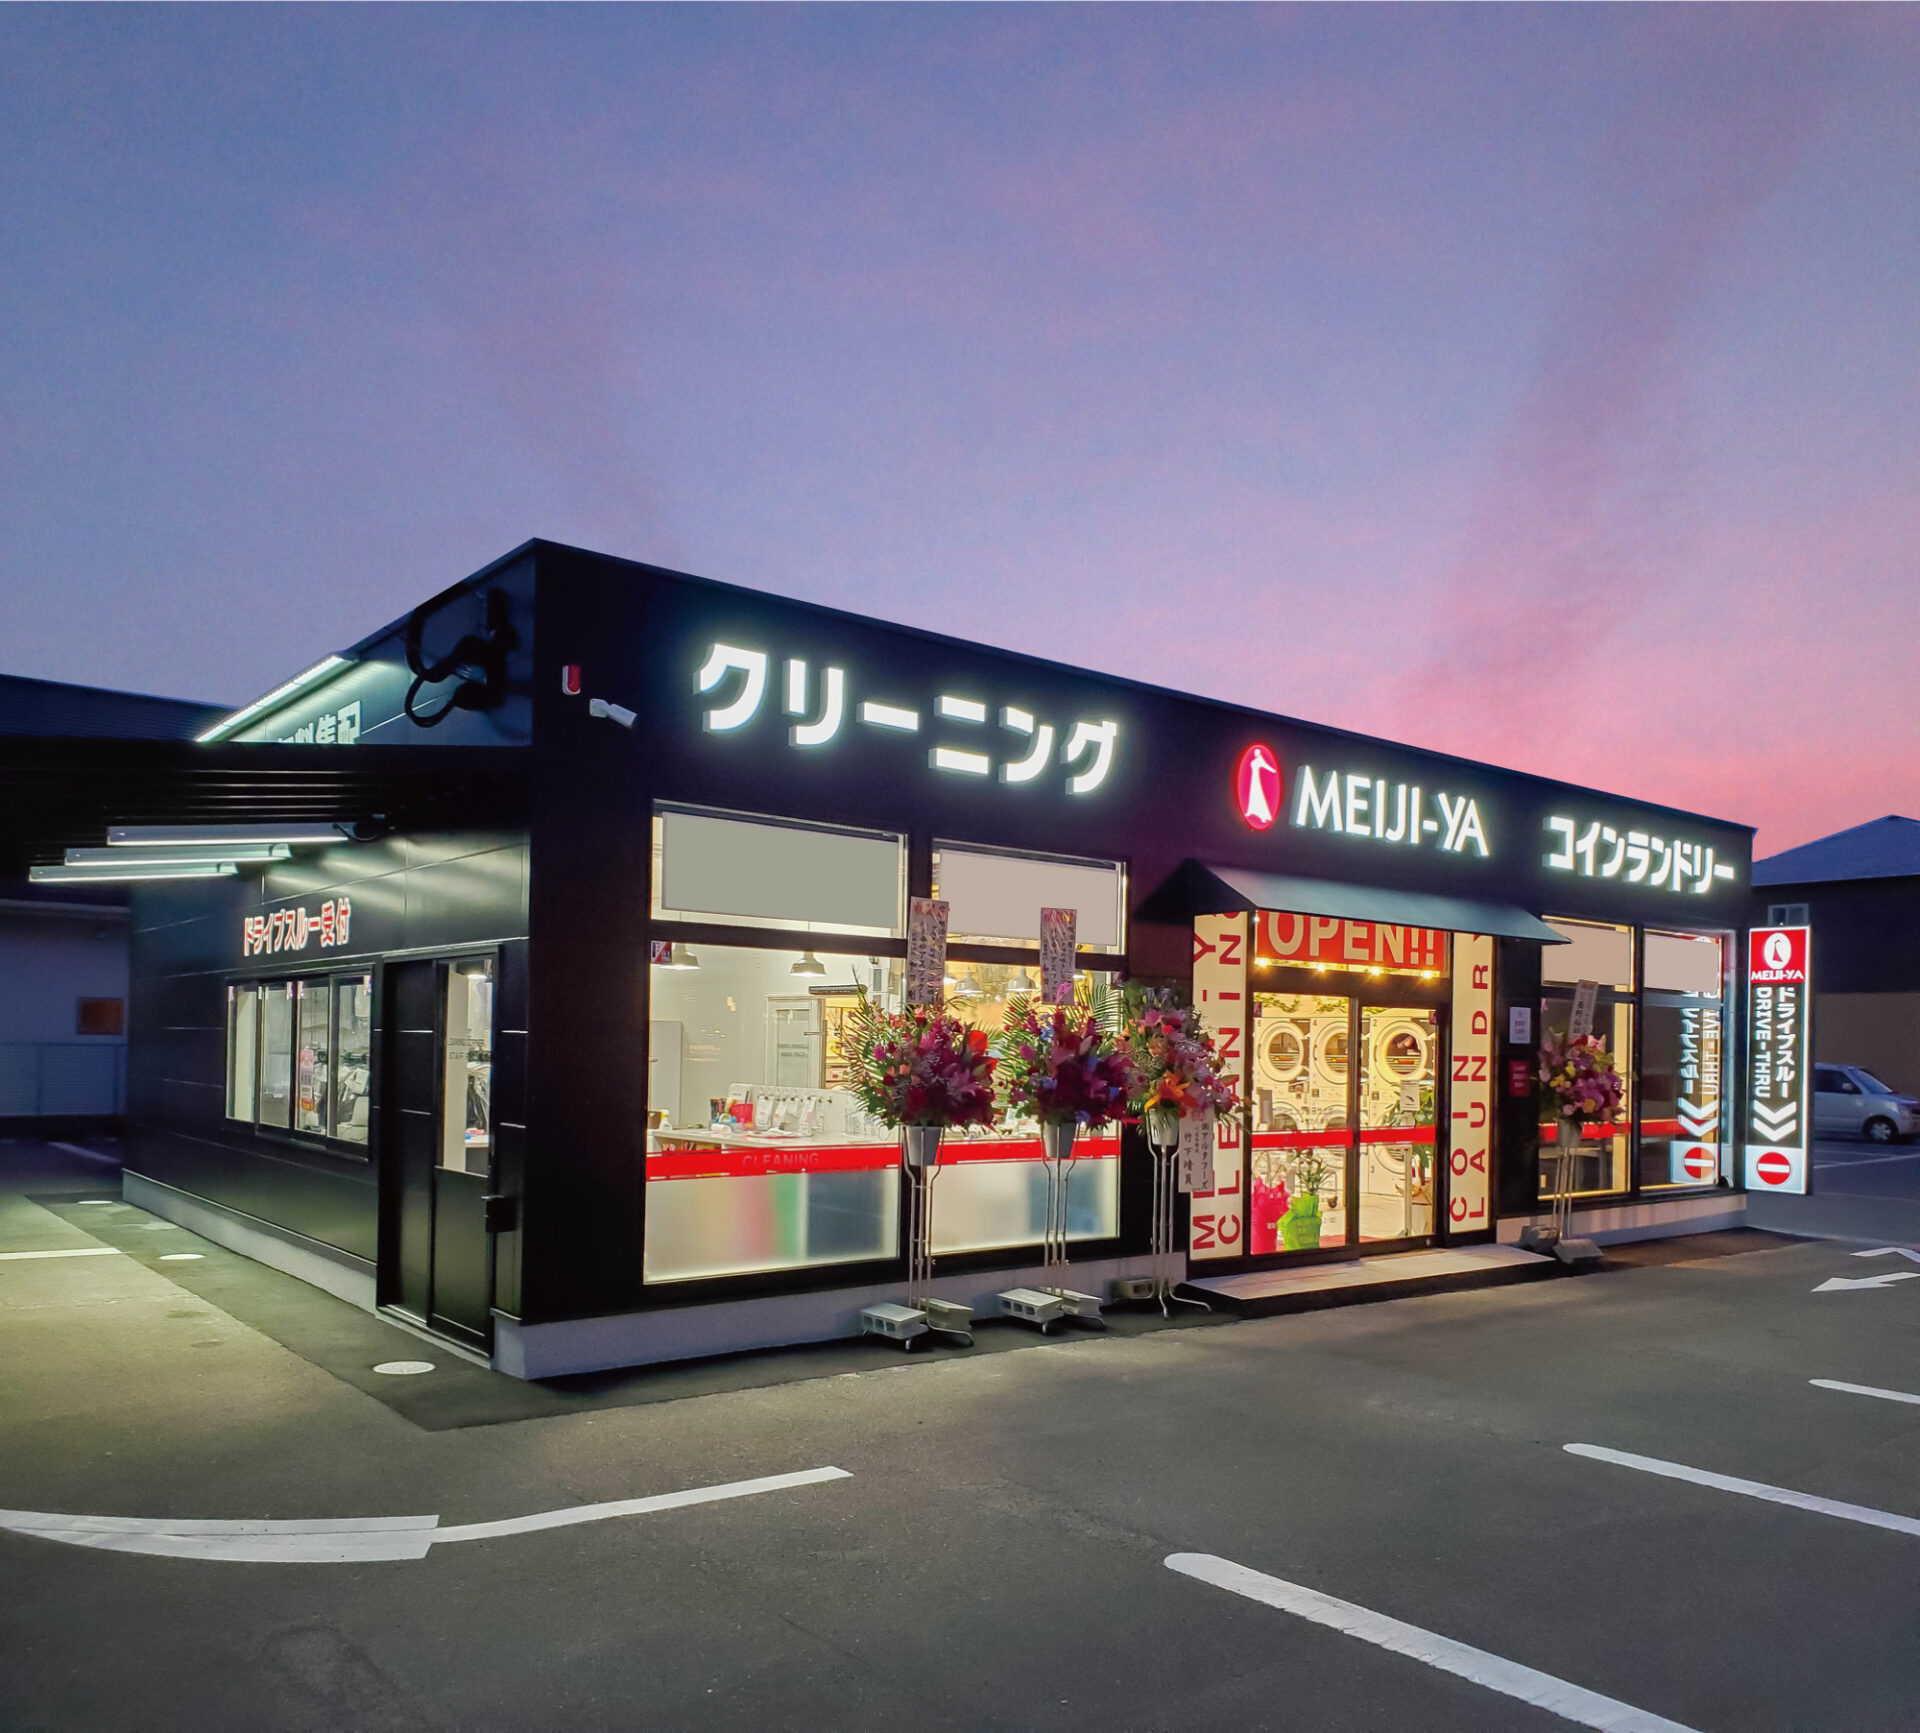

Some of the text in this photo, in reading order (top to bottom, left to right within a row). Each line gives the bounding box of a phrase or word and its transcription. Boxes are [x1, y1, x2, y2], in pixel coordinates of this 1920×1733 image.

[694, 643, 1118, 796] クリーニング
[1291, 765, 1489, 856] MEIJI-YA
[1543, 816, 1734, 894] コインランドリー
[244, 897, 351, 957] ドライブスルー受付
[1751, 969, 1804, 981] MEIJI-YA
[1218, 912, 1241, 1244] CLEANIN
[1469, 935, 1489, 1218] LAUNDR
[1755, 986, 1772, 1098] DRIVE-THRU
[1776, 986, 1796, 1098] ドライブスルー
[1450, 1055, 1469, 1222] COIN
